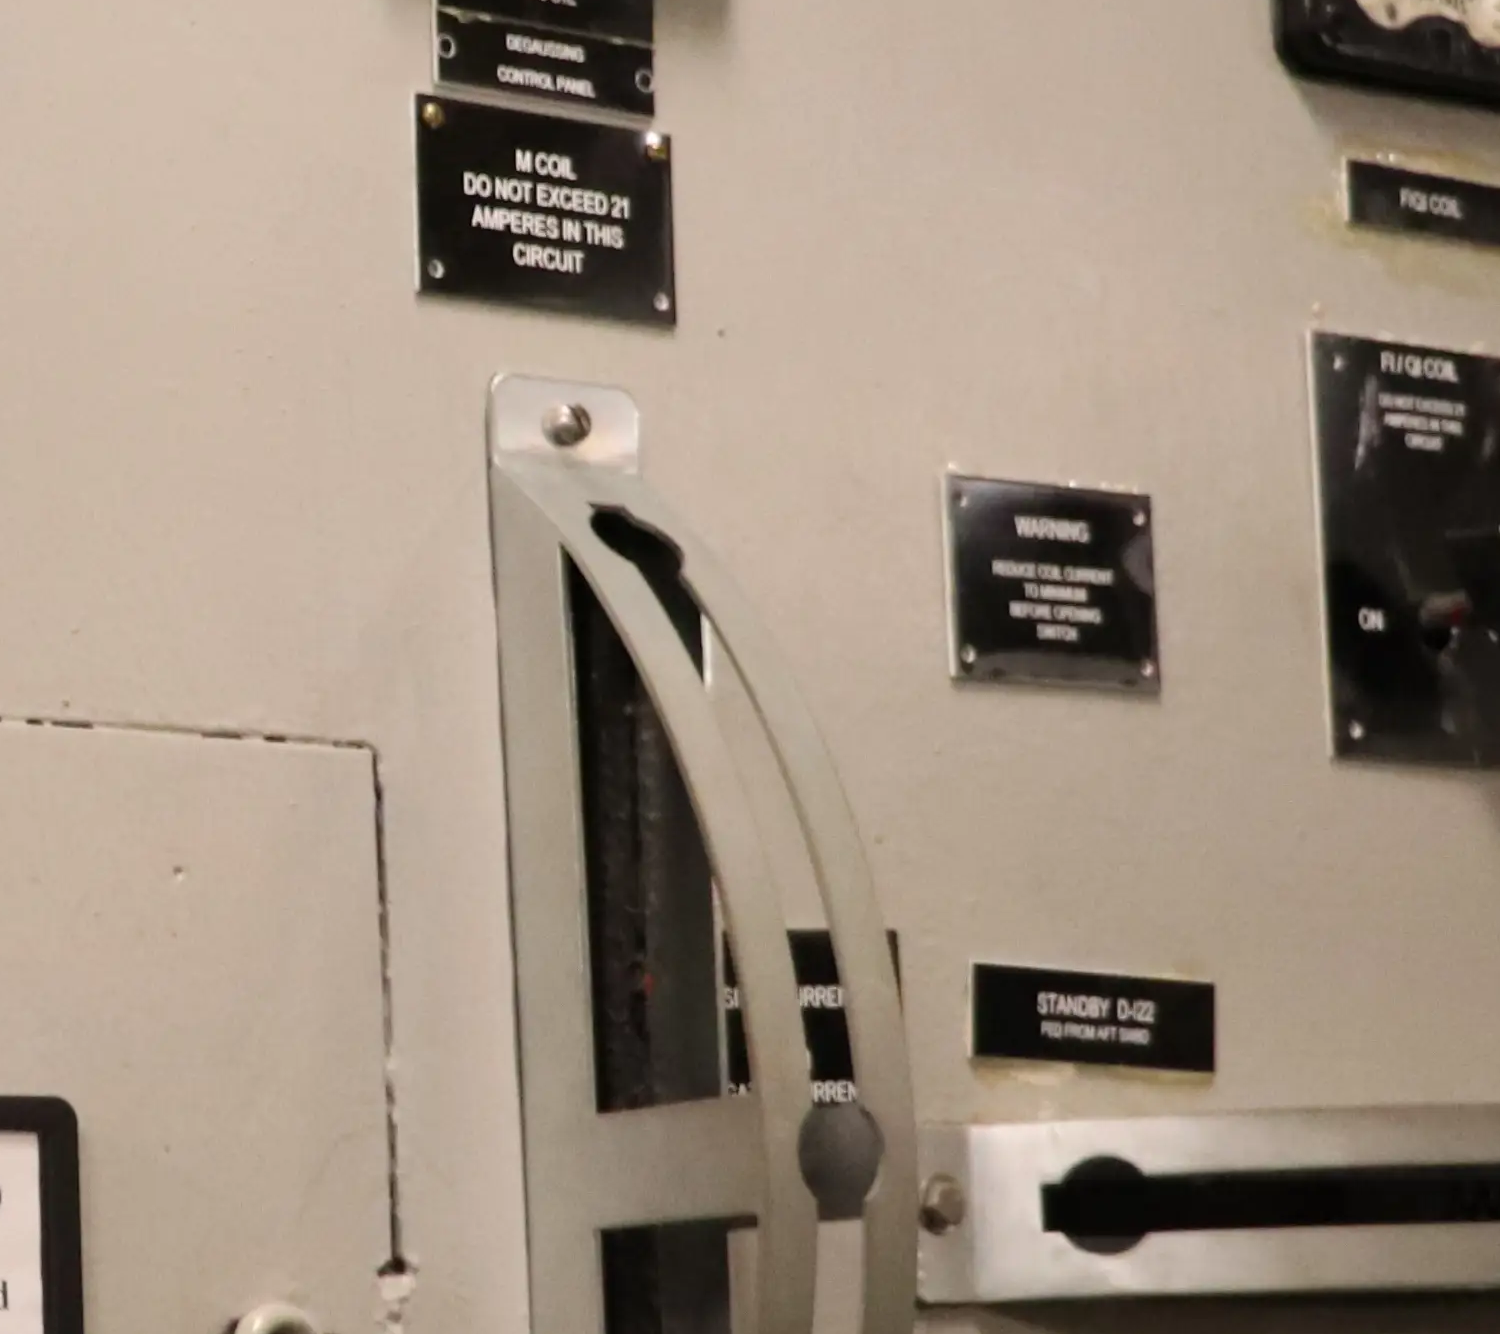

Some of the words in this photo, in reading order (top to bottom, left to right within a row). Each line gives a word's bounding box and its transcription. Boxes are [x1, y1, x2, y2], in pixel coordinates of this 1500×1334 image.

[515, 148, 533, 174] M
[535, 154, 577, 181] COIL
[463, 171, 492, 198] DO
[495, 176, 532, 205] NOT
[536, 183, 608, 216] EXCEED
[611, 195, 630, 220] 21
[471, 204, 560, 241] AMPERES
[562, 219, 583, 244] IN
[585, 223, 625, 251] THIS
[513, 242, 585, 275] CIRCUIT
[1014, 515, 1091, 544] WARNING
[1358, 607, 1387, 632] ON
[1037, 991, 1110, 1019] STANDBY
